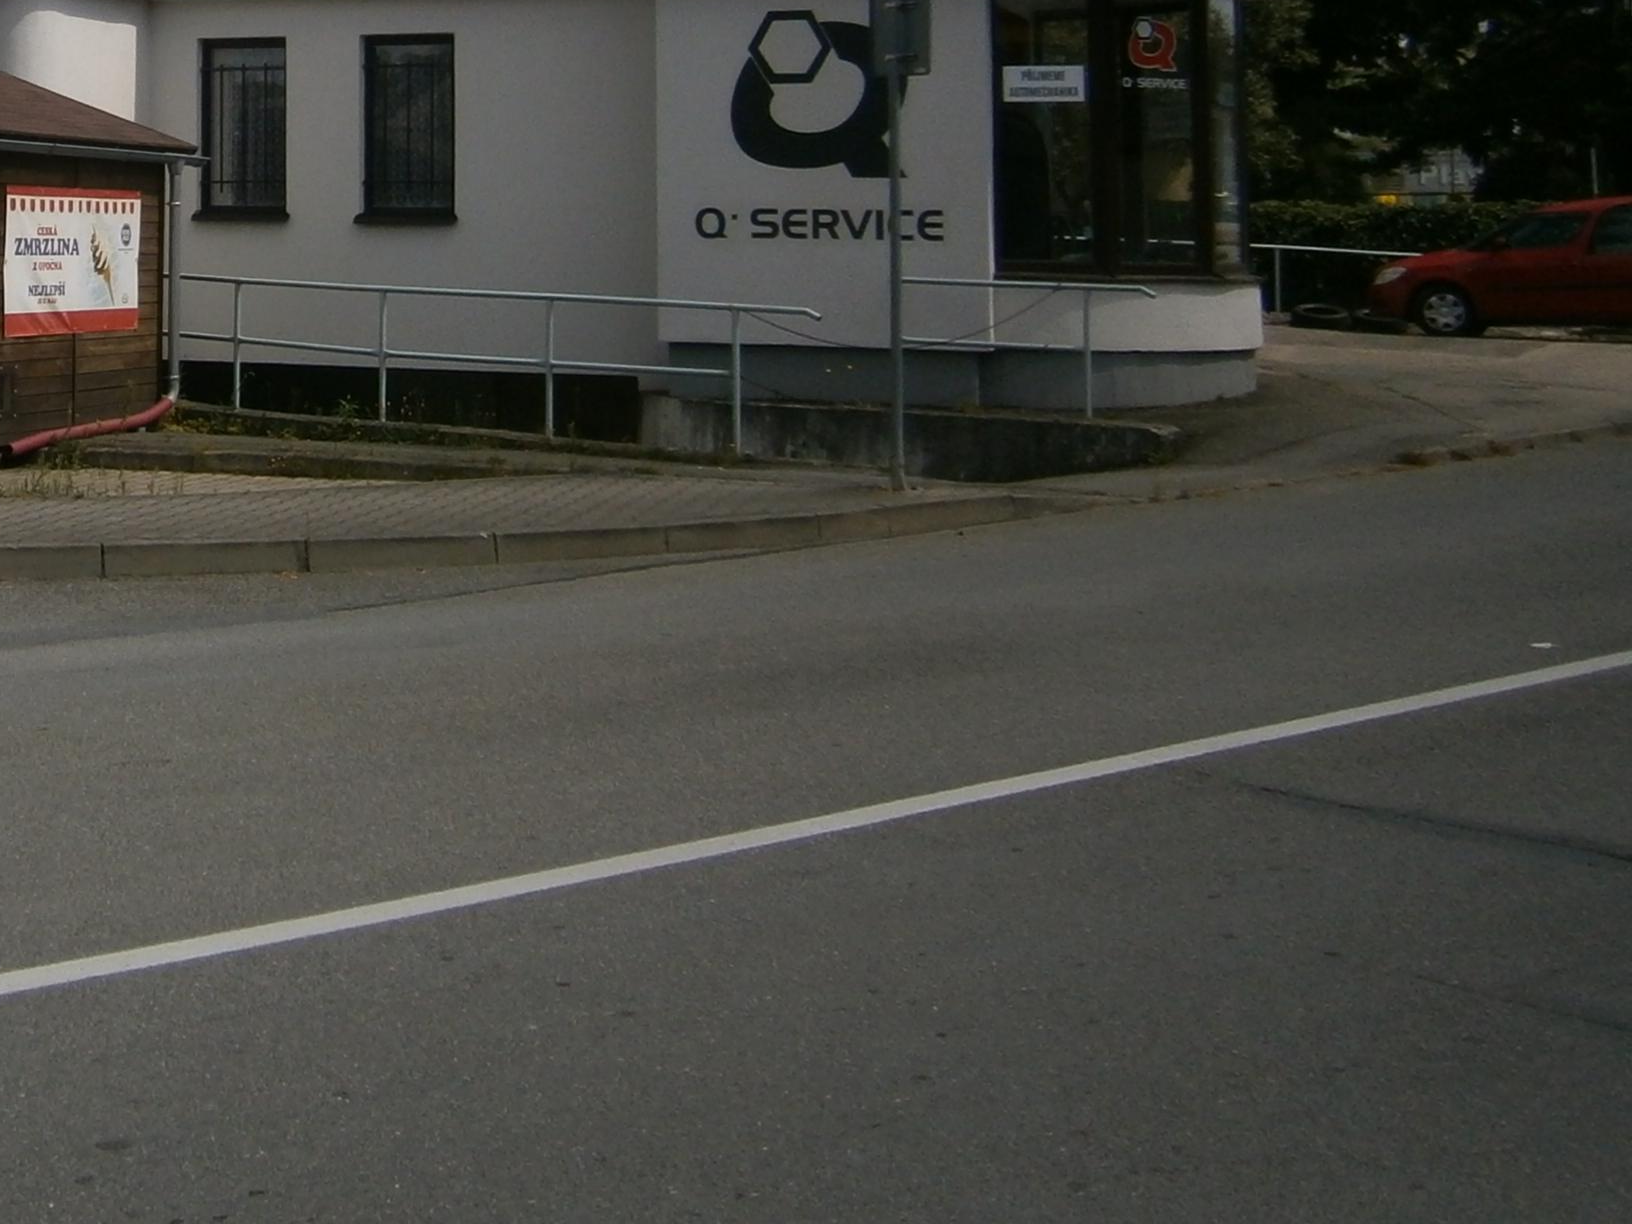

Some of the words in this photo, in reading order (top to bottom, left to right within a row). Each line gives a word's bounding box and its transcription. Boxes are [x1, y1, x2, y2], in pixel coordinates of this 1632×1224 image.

[1137, 78, 1186, 89] SERVICE
[750, 208, 944, 241] SERVICE
[14, 238, 80, 256] ZMRZLINA
[28, 281, 66, 297] NEJLEPŠÍ
